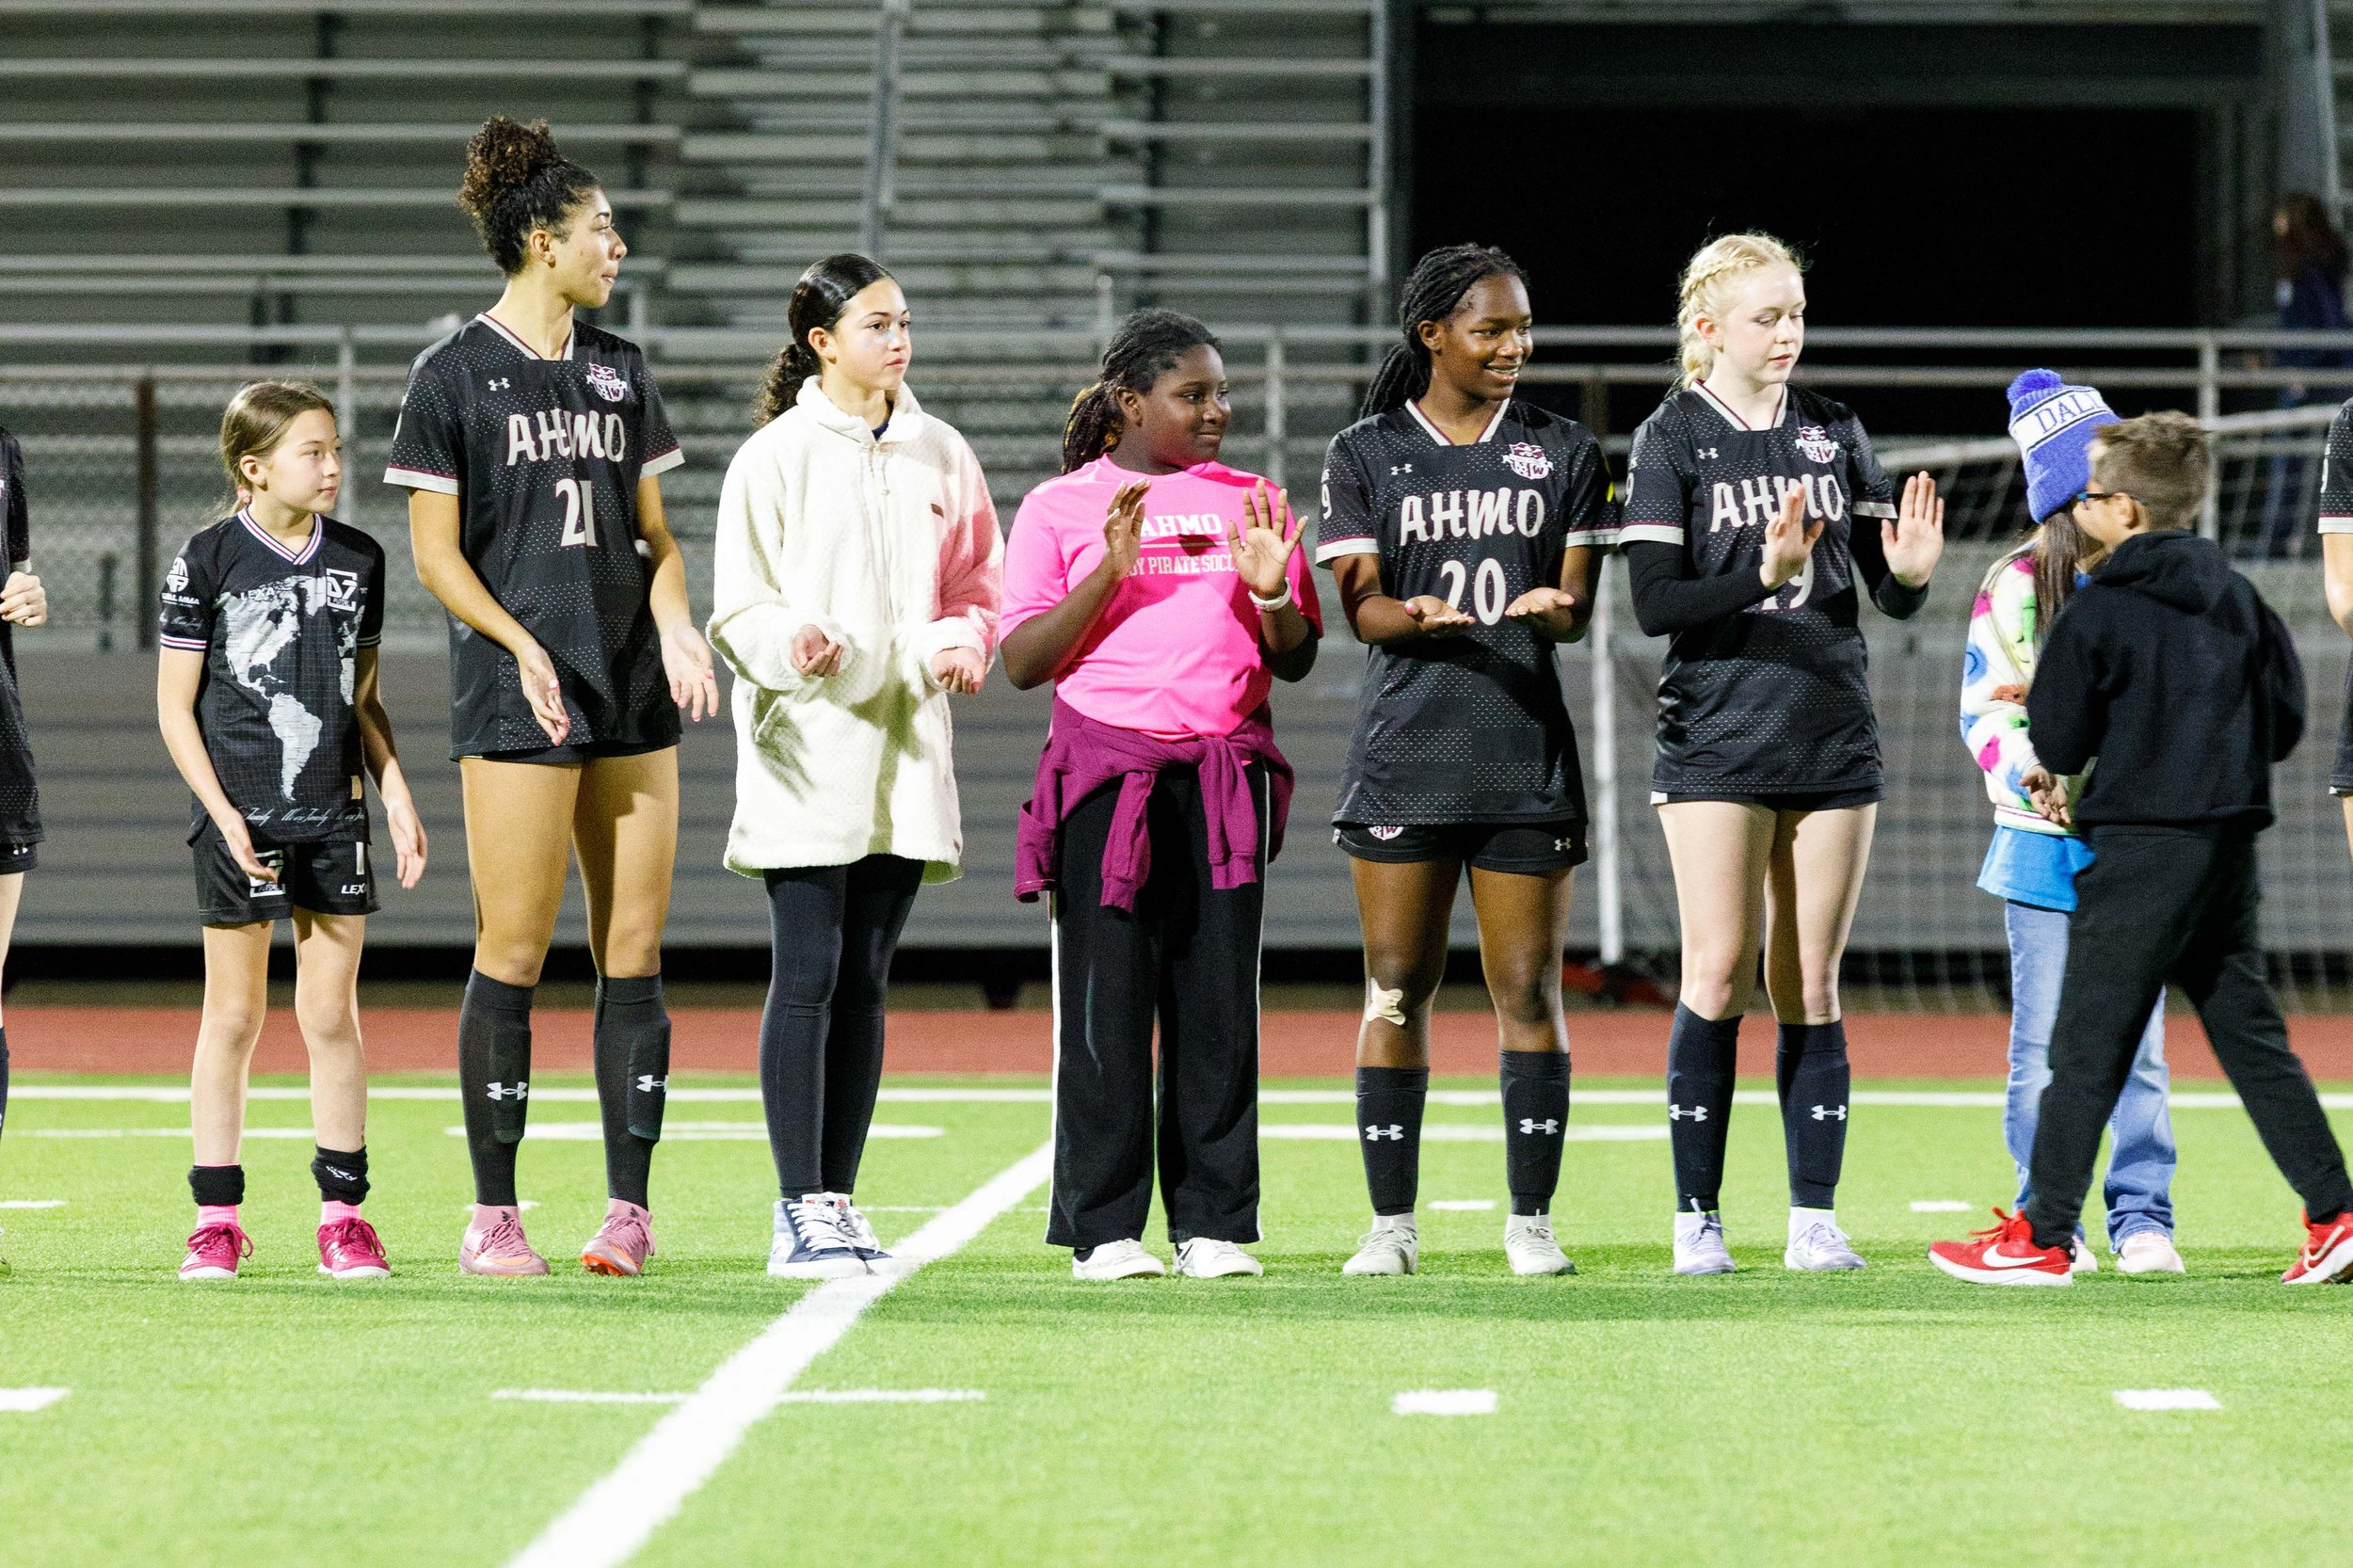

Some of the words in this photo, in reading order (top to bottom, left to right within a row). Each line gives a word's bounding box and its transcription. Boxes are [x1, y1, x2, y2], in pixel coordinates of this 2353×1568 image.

[506, 408, 627, 466] AHMO
[555, 478, 598, 547] 21
[1140, 513, 1223, 537] AHMO
[1401, 487, 1545, 546] AHMO
[1709, 473, 1845, 533] AHMO
[1148, 554, 1200, 575] PIRATE
[1440, 557, 1507, 626] 20
